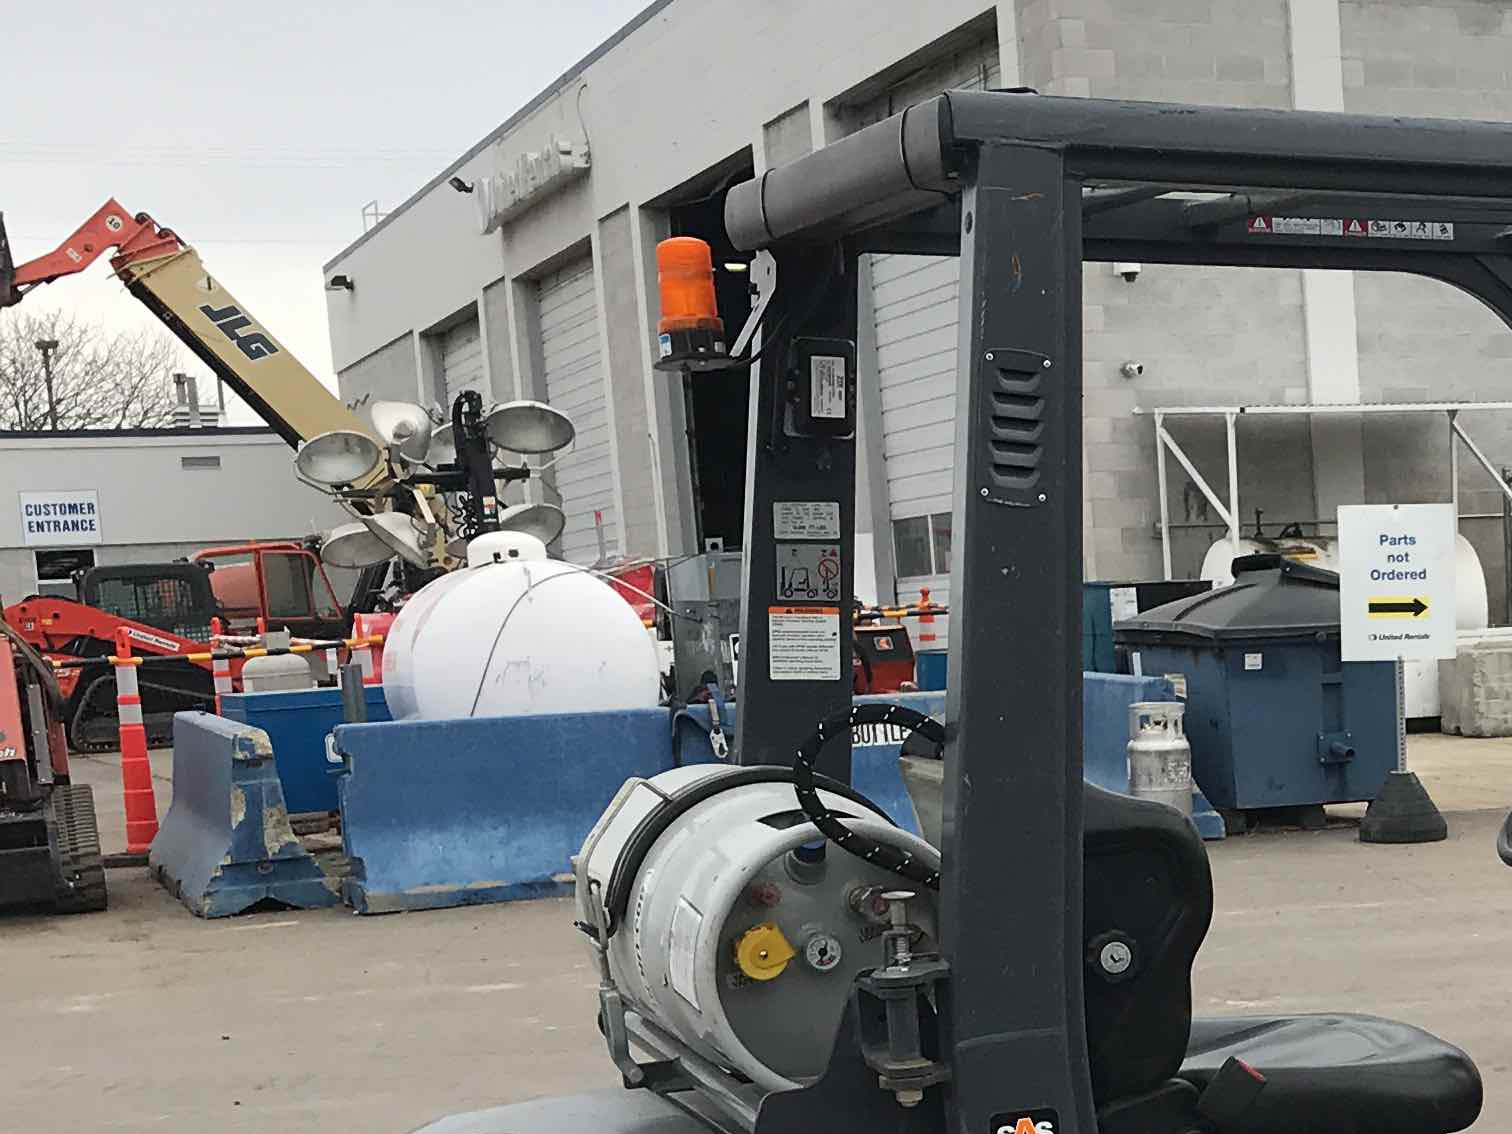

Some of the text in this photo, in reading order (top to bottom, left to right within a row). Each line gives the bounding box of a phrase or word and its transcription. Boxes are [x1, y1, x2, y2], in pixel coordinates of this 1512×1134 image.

[199, 304, 280, 361] JLG
[25, 502, 95, 516] CUSTOMER
[27, 519, 96, 533] ENTRANCE
[1379, 534, 1417, 546] Parts
[1387, 552, 1409, 563] not
[1370, 569, 1427, 581] Ordered
